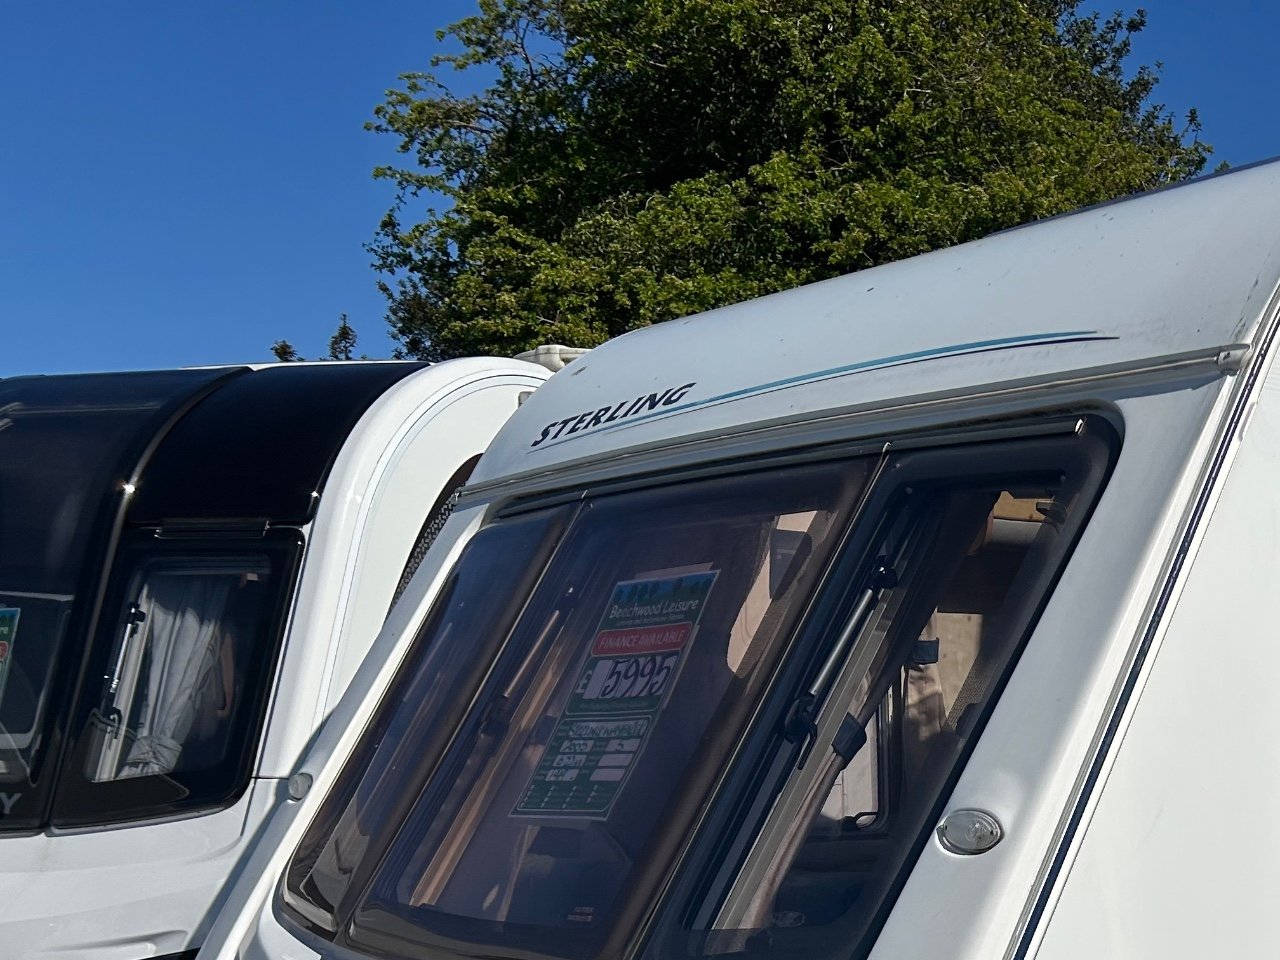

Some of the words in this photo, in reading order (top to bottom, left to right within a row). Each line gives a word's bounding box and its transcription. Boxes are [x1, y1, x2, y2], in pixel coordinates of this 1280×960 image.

[531, 382, 697, 447] STERLING
[608, 600, 662, 619] Beechwood
[663, 599, 700, 614] Leisure
[599, 634, 638, 649] FINANCE
[638, 630, 685, 647] AVAILABLE
[600, 654, 674, 697] 5995
